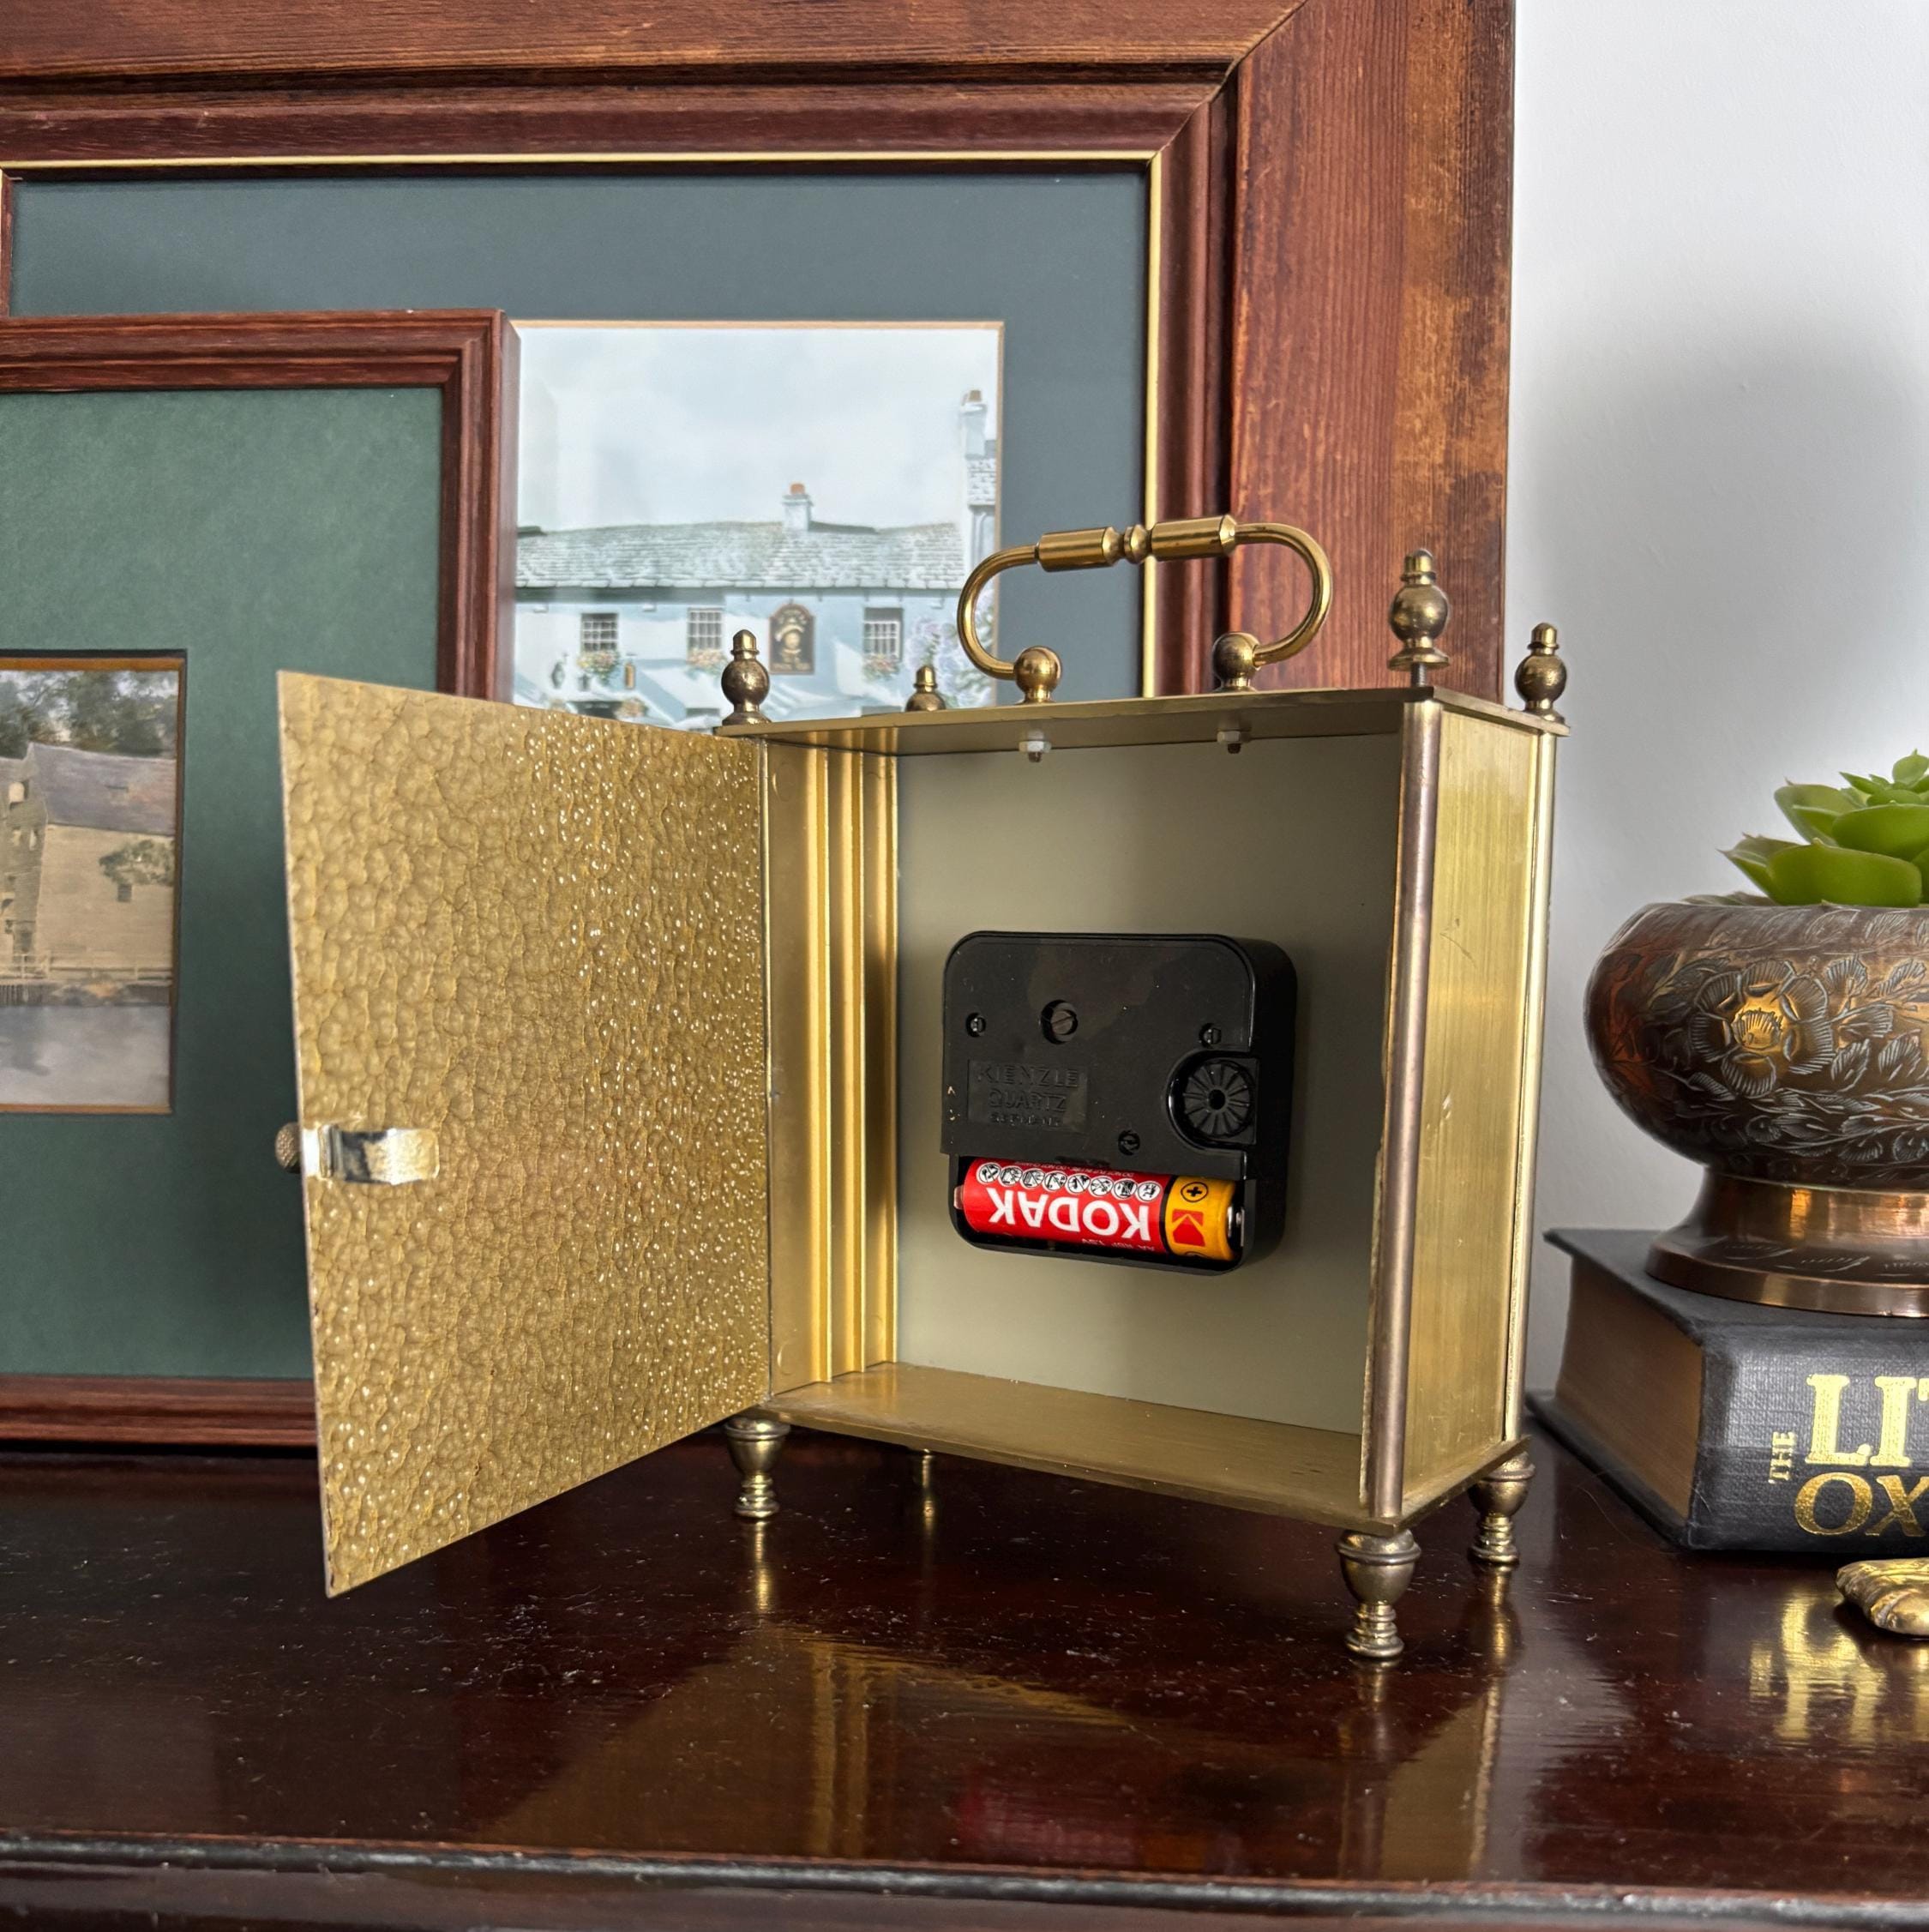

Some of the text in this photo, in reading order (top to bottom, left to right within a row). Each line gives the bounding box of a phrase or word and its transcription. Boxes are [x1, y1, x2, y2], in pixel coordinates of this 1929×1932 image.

[977, 1064, 1079, 1088] KIENZLE
[989, 1089, 1066, 1113] QUARTZ
[987, 1188, 1151, 1241] KODAK
[1805, 1374, 1929, 1467] LI
[1768, 1431, 1796, 1484] THE
[1794, 1472, 1929, 1537] OX
